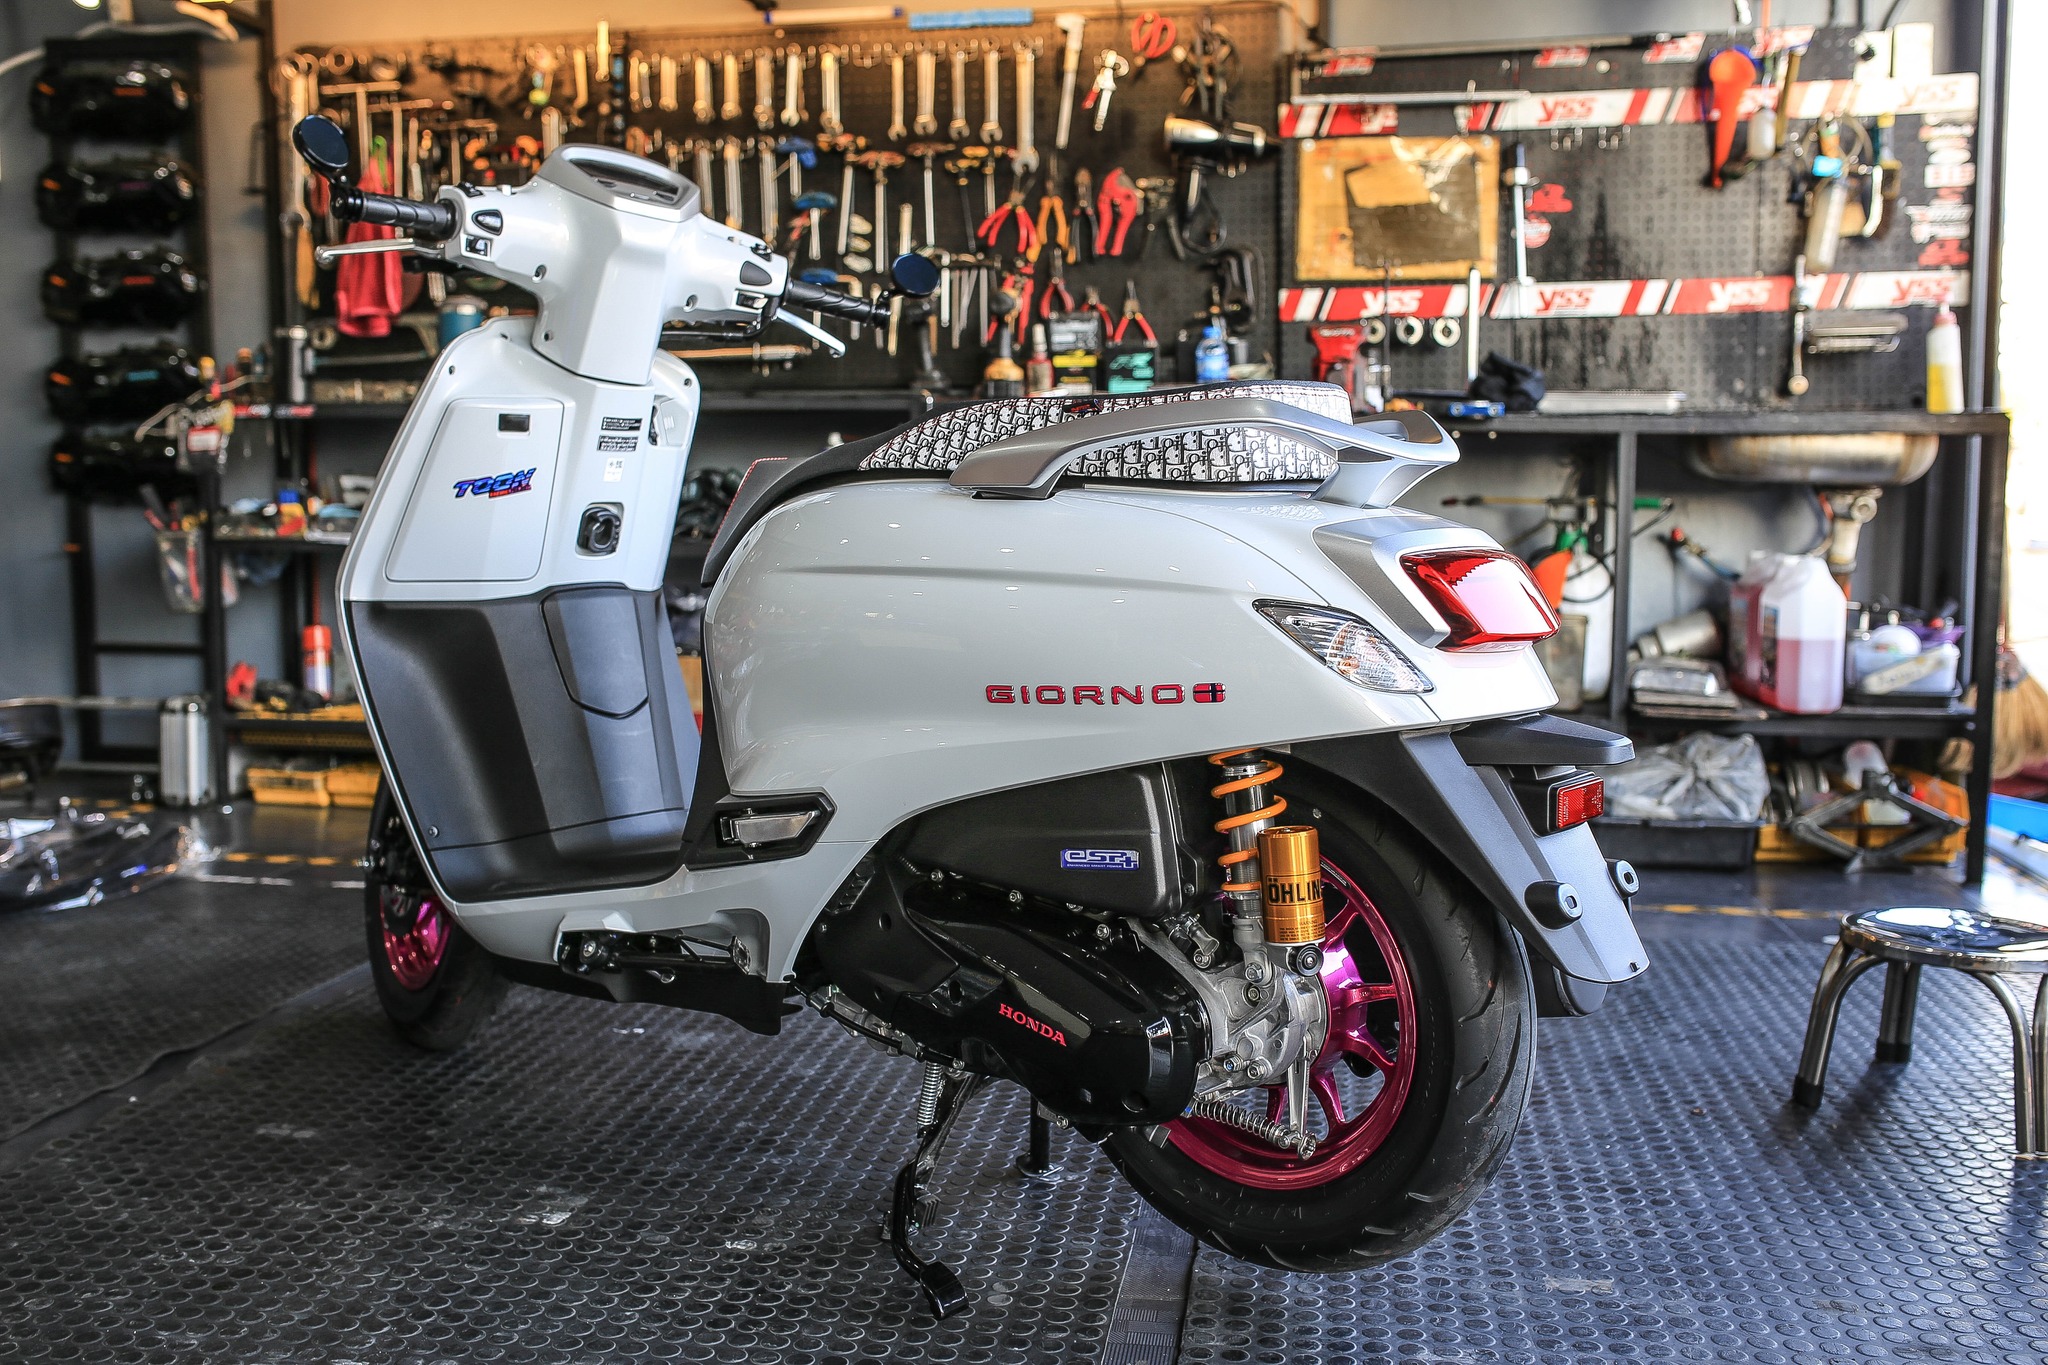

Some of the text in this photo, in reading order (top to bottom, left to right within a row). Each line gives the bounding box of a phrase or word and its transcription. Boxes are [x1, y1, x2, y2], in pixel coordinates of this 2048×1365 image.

[986, 684, 1186, 705] GIORNO
[1268, 877, 1321, 904] ÖHLIN
[998, 1003, 1067, 1047] HONDA
